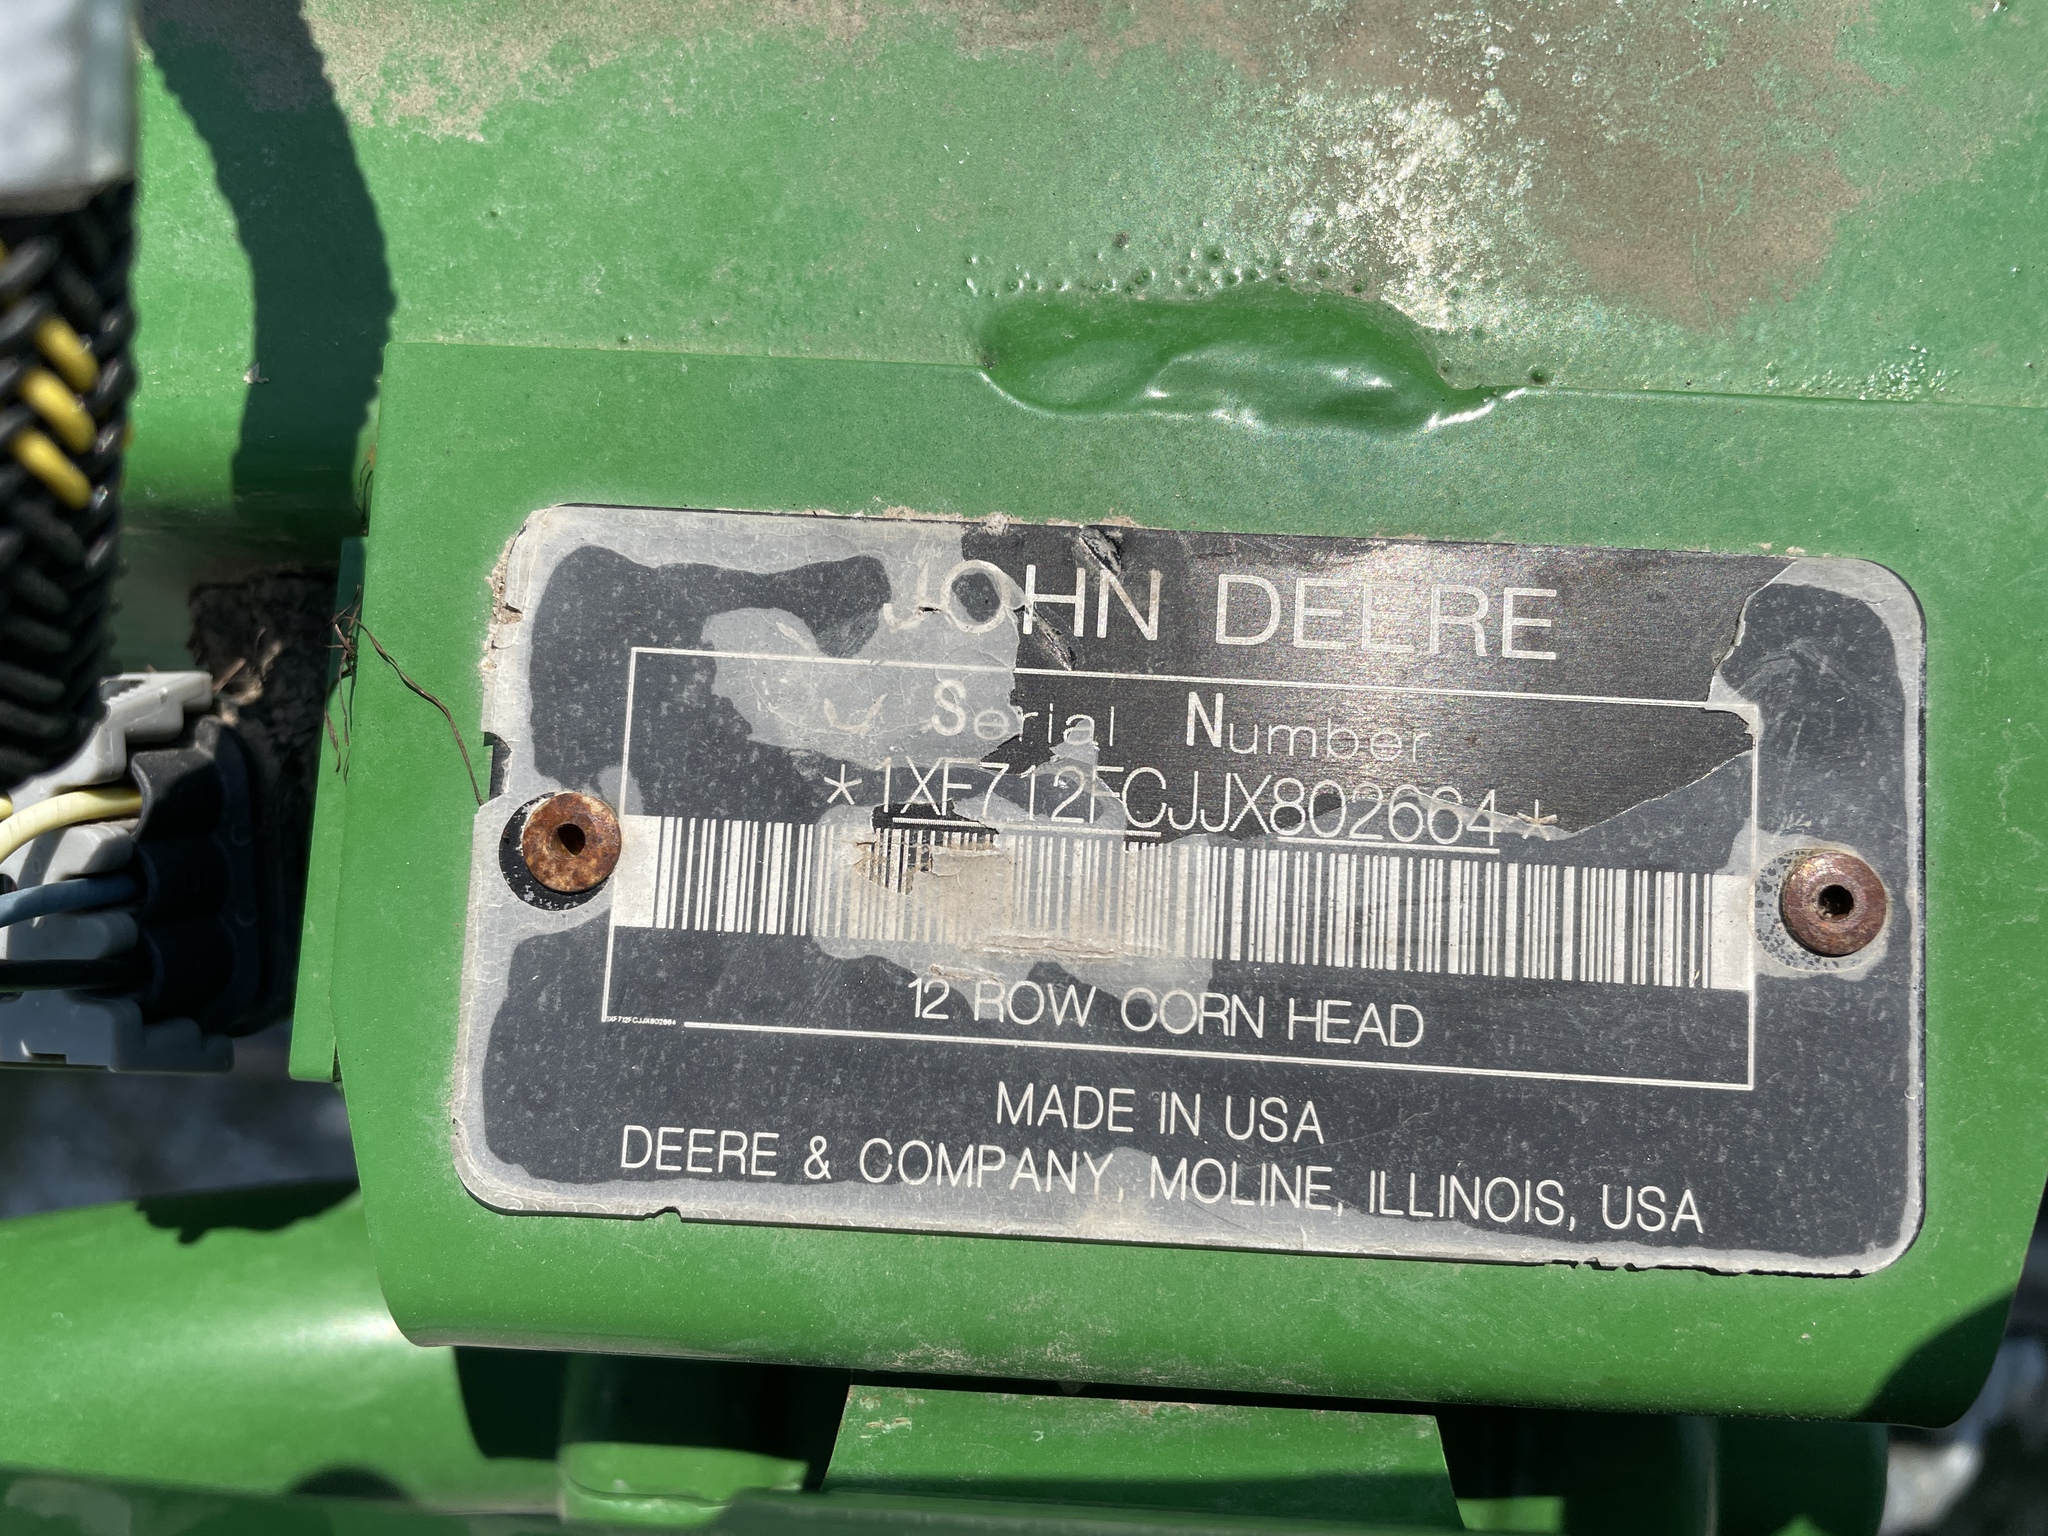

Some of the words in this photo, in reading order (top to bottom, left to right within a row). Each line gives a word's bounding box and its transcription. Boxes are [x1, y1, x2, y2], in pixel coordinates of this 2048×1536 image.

[882, 558, 1161, 641] JOHN
[1215, 573, 1559, 661] DEERE
[930, 679, 1116, 747] Serial
[1186, 691, 1433, 762] Number
[908, 977, 951, 1020] 12
[972, 979, 1097, 1027] ROW
[1119, 987, 1265, 1039] CORN
[1286, 997, 1425, 1048] HEAD
[996, 1081, 1135, 1134] MADE
[1159, 1091, 1202, 1136] IN
[1224, 1095, 1325, 1145] USA
[620, 1124, 780, 1177] DEERE
[803, 1134, 832, 1181] &
[1149, 1155, 1345, 1217] MOLINE,
[1368, 1169, 1577, 1233] ILLINOIS,
[1600, 1182, 1705, 1234] USA
